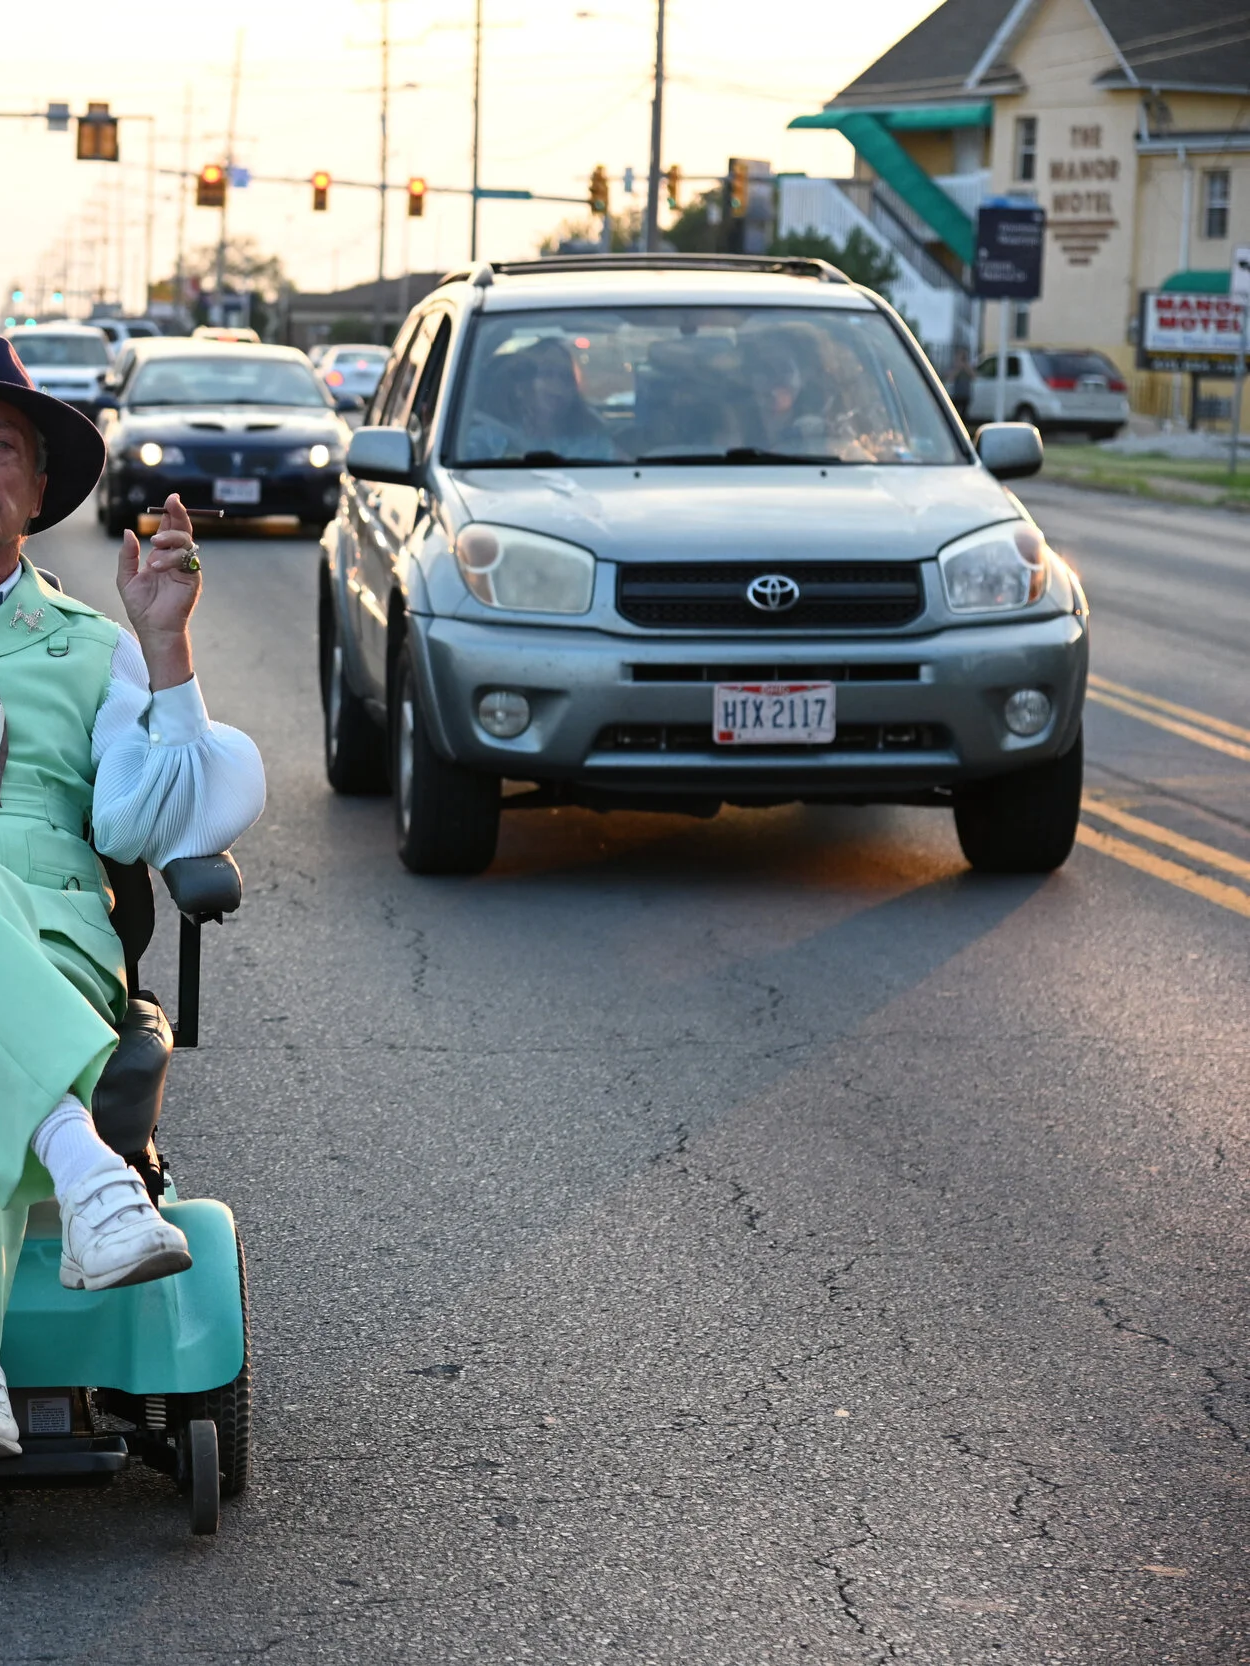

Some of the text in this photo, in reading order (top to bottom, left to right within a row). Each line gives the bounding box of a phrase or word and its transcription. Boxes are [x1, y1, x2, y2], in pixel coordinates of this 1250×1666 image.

[1071, 125, 1102, 149] THE
[1050, 157, 1119, 181] MANOR
[1052, 190, 1112, 213] MOTEL
[1159, 316, 1242, 334] MOTEL
[723, 699, 827, 729] HIX 2117
